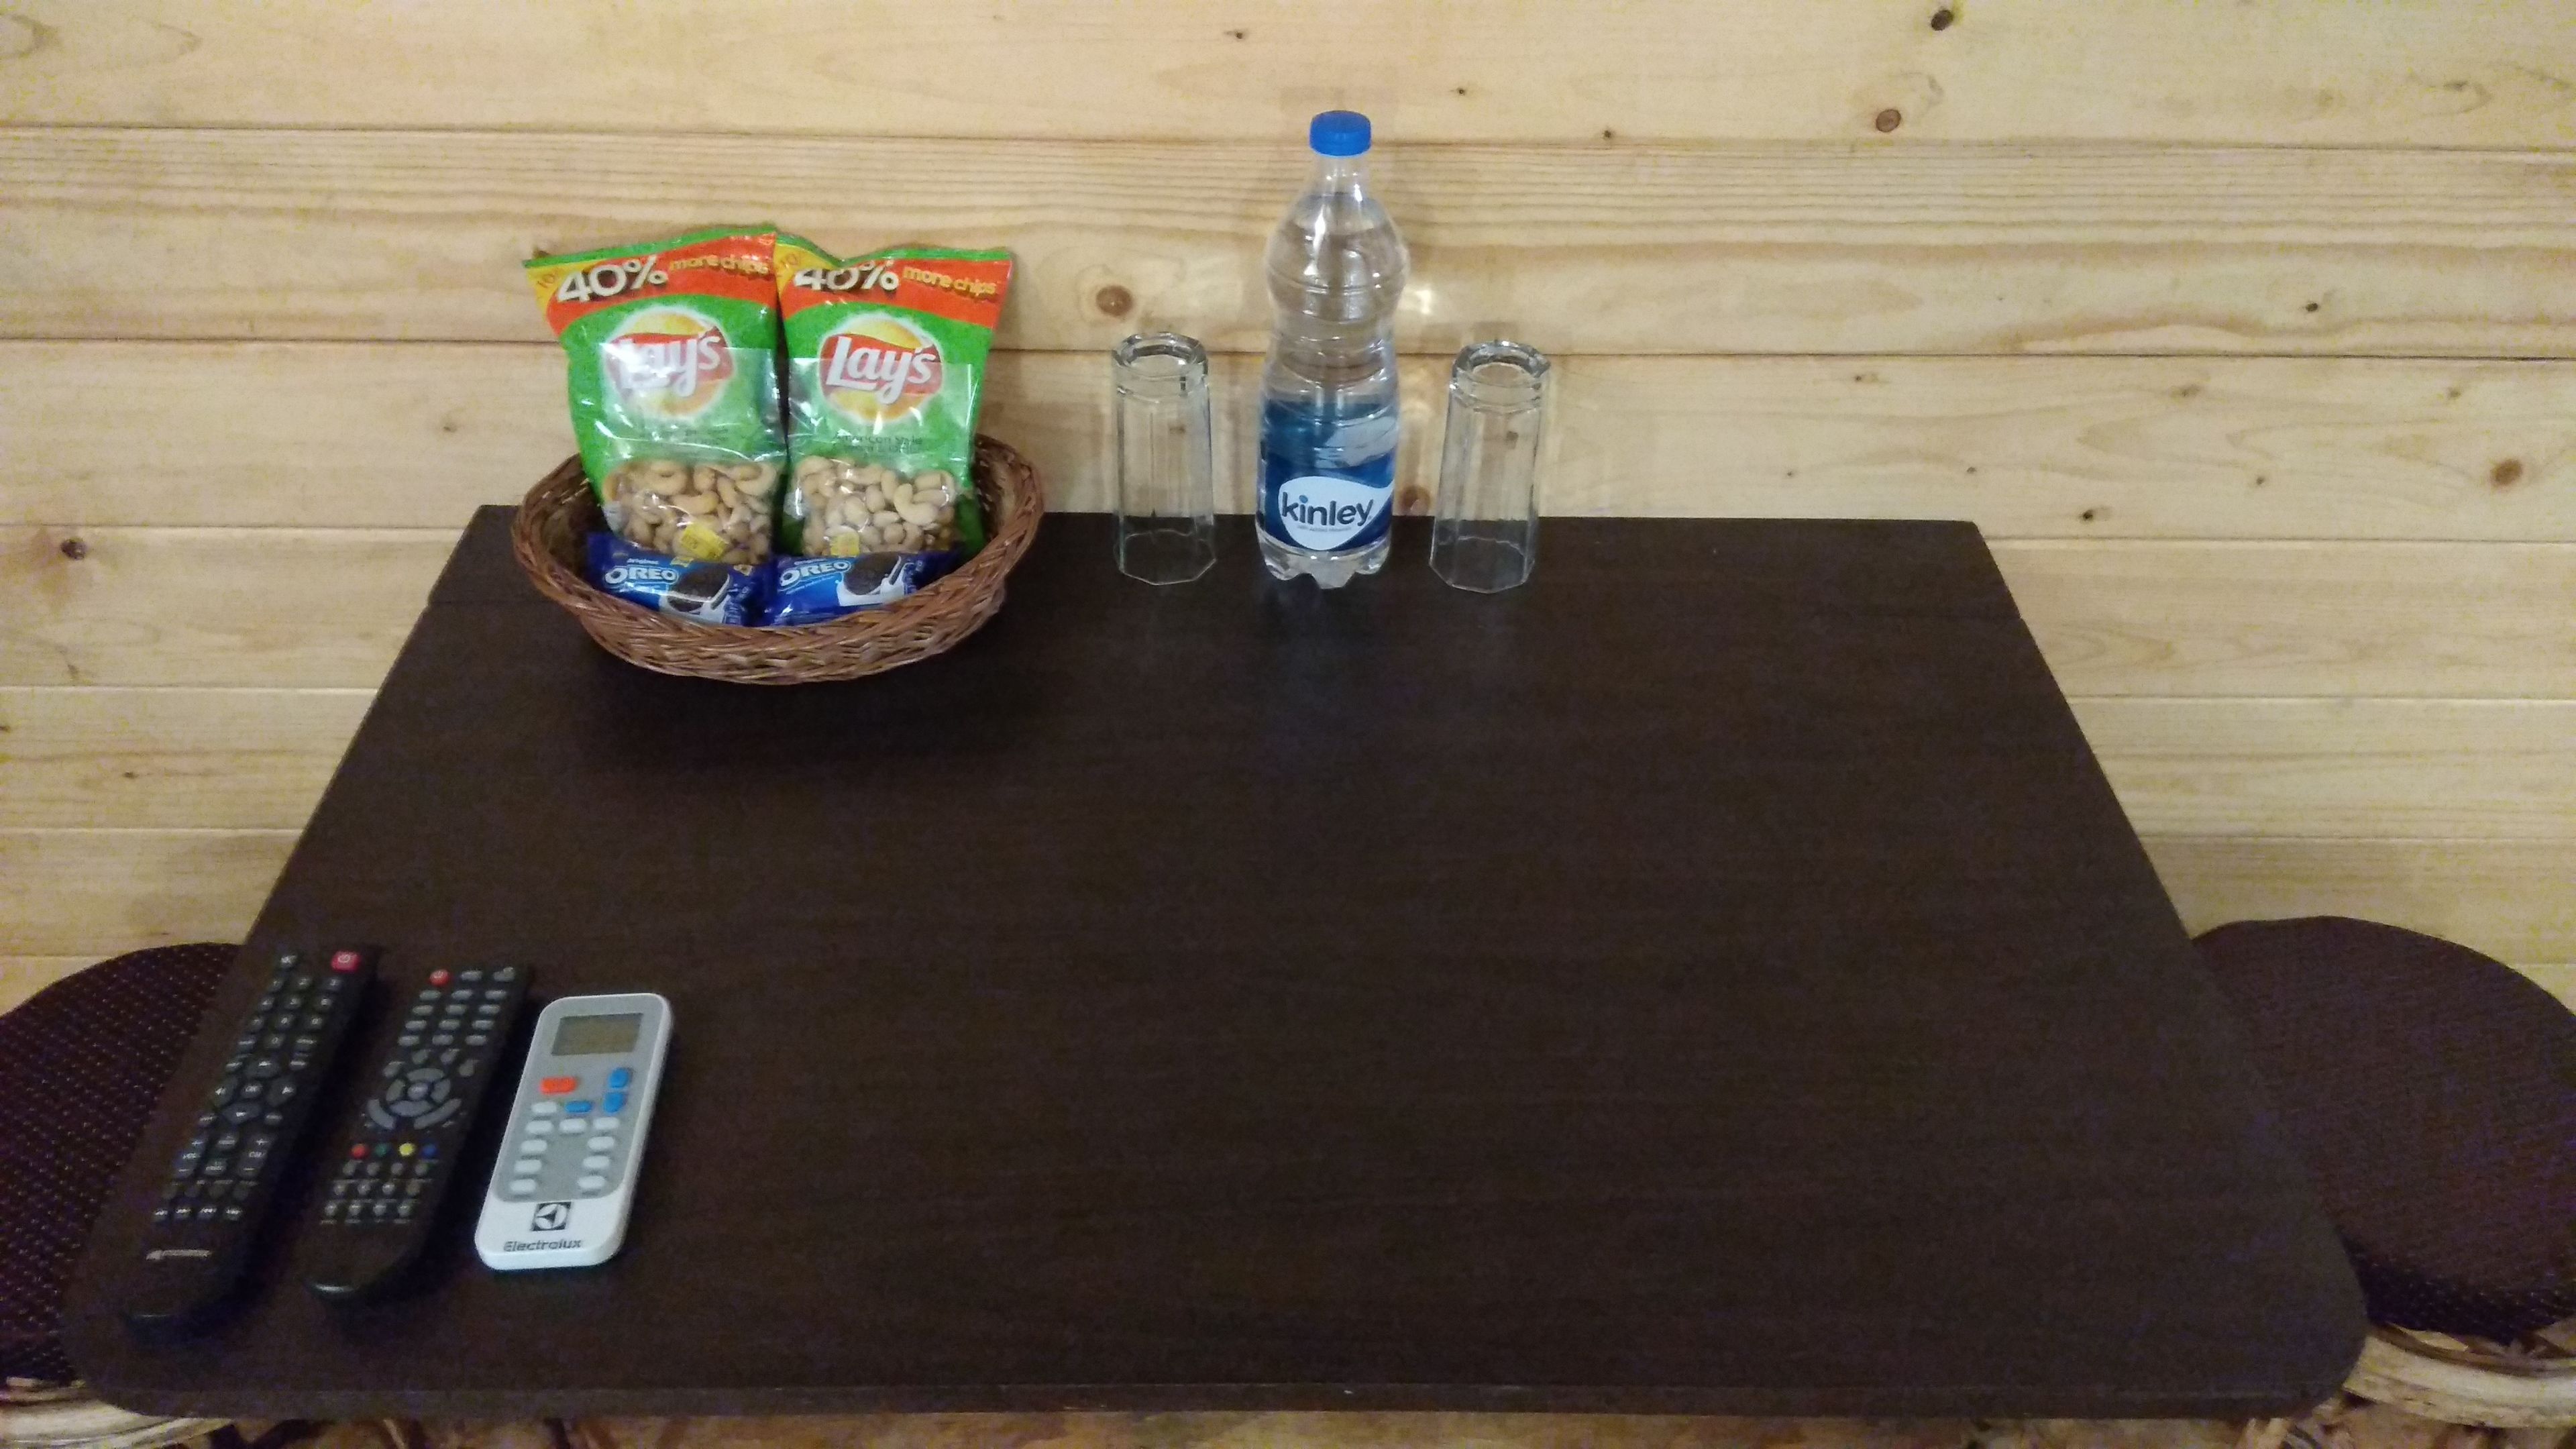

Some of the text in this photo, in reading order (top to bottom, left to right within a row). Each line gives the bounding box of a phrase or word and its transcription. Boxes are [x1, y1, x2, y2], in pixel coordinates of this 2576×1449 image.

[558, 255, 668, 302] 40%
[794, 260, 997, 296] 40% more chips
[826, 336, 936, 405] Lay's
[1282, 492, 1374, 527] kinley
[604, 568, 677, 584] OREO
[780, 561, 849, 586] OREO
[503, 1239, 582, 1252] Electrolux
